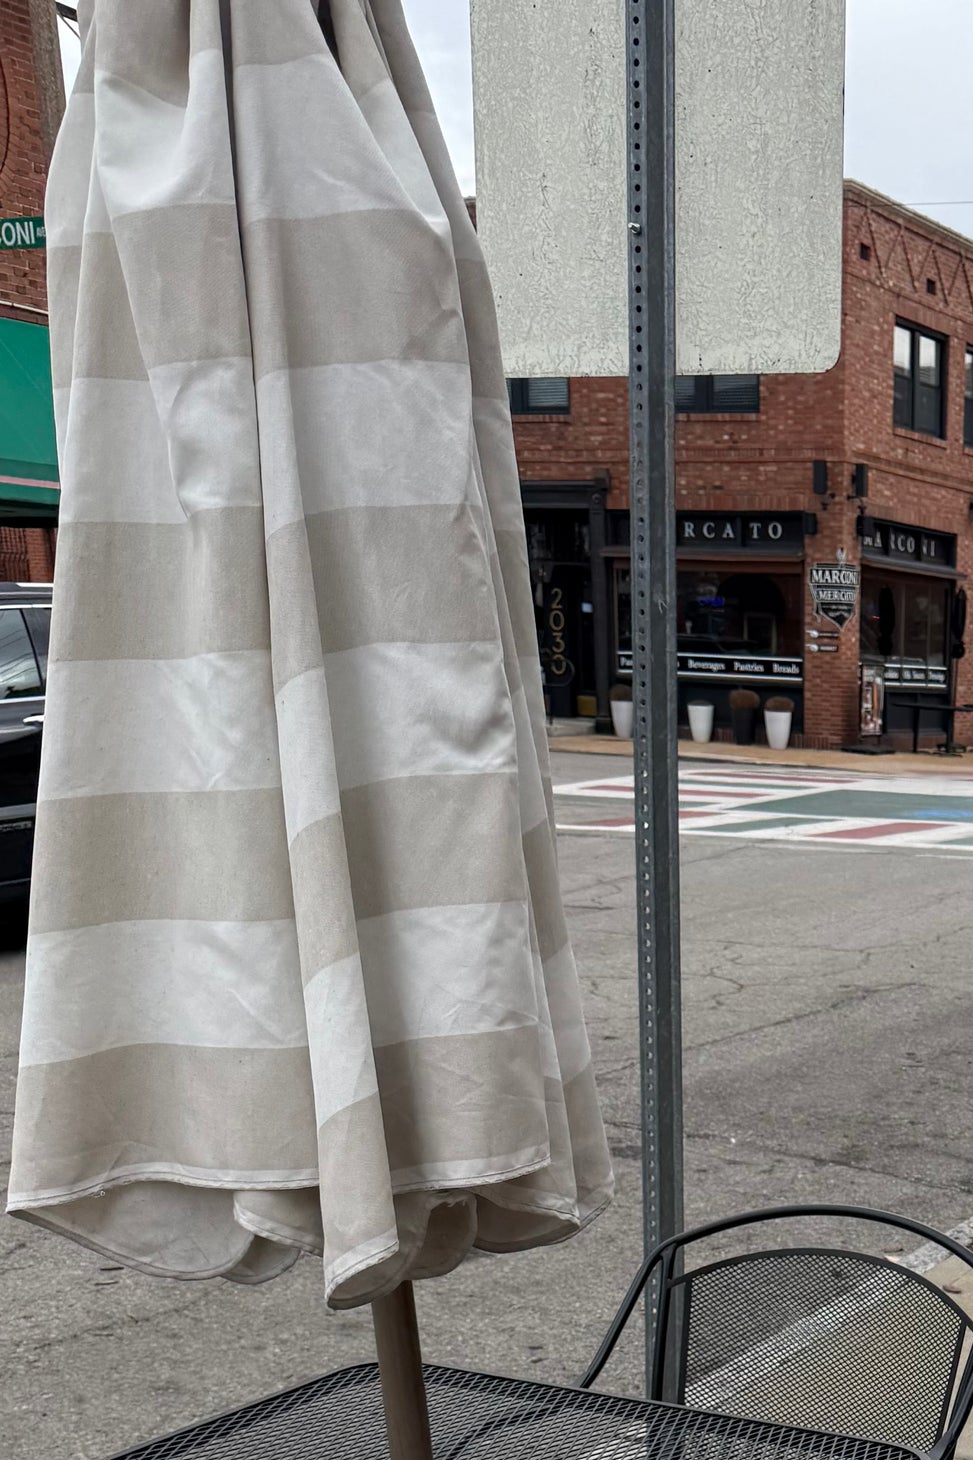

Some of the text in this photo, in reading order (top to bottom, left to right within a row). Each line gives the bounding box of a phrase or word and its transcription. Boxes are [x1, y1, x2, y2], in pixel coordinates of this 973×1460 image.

[0, 221, 35, 246] ONI
[684, 521, 783, 540] RCATO
[549, 587, 567, 675] 2030
